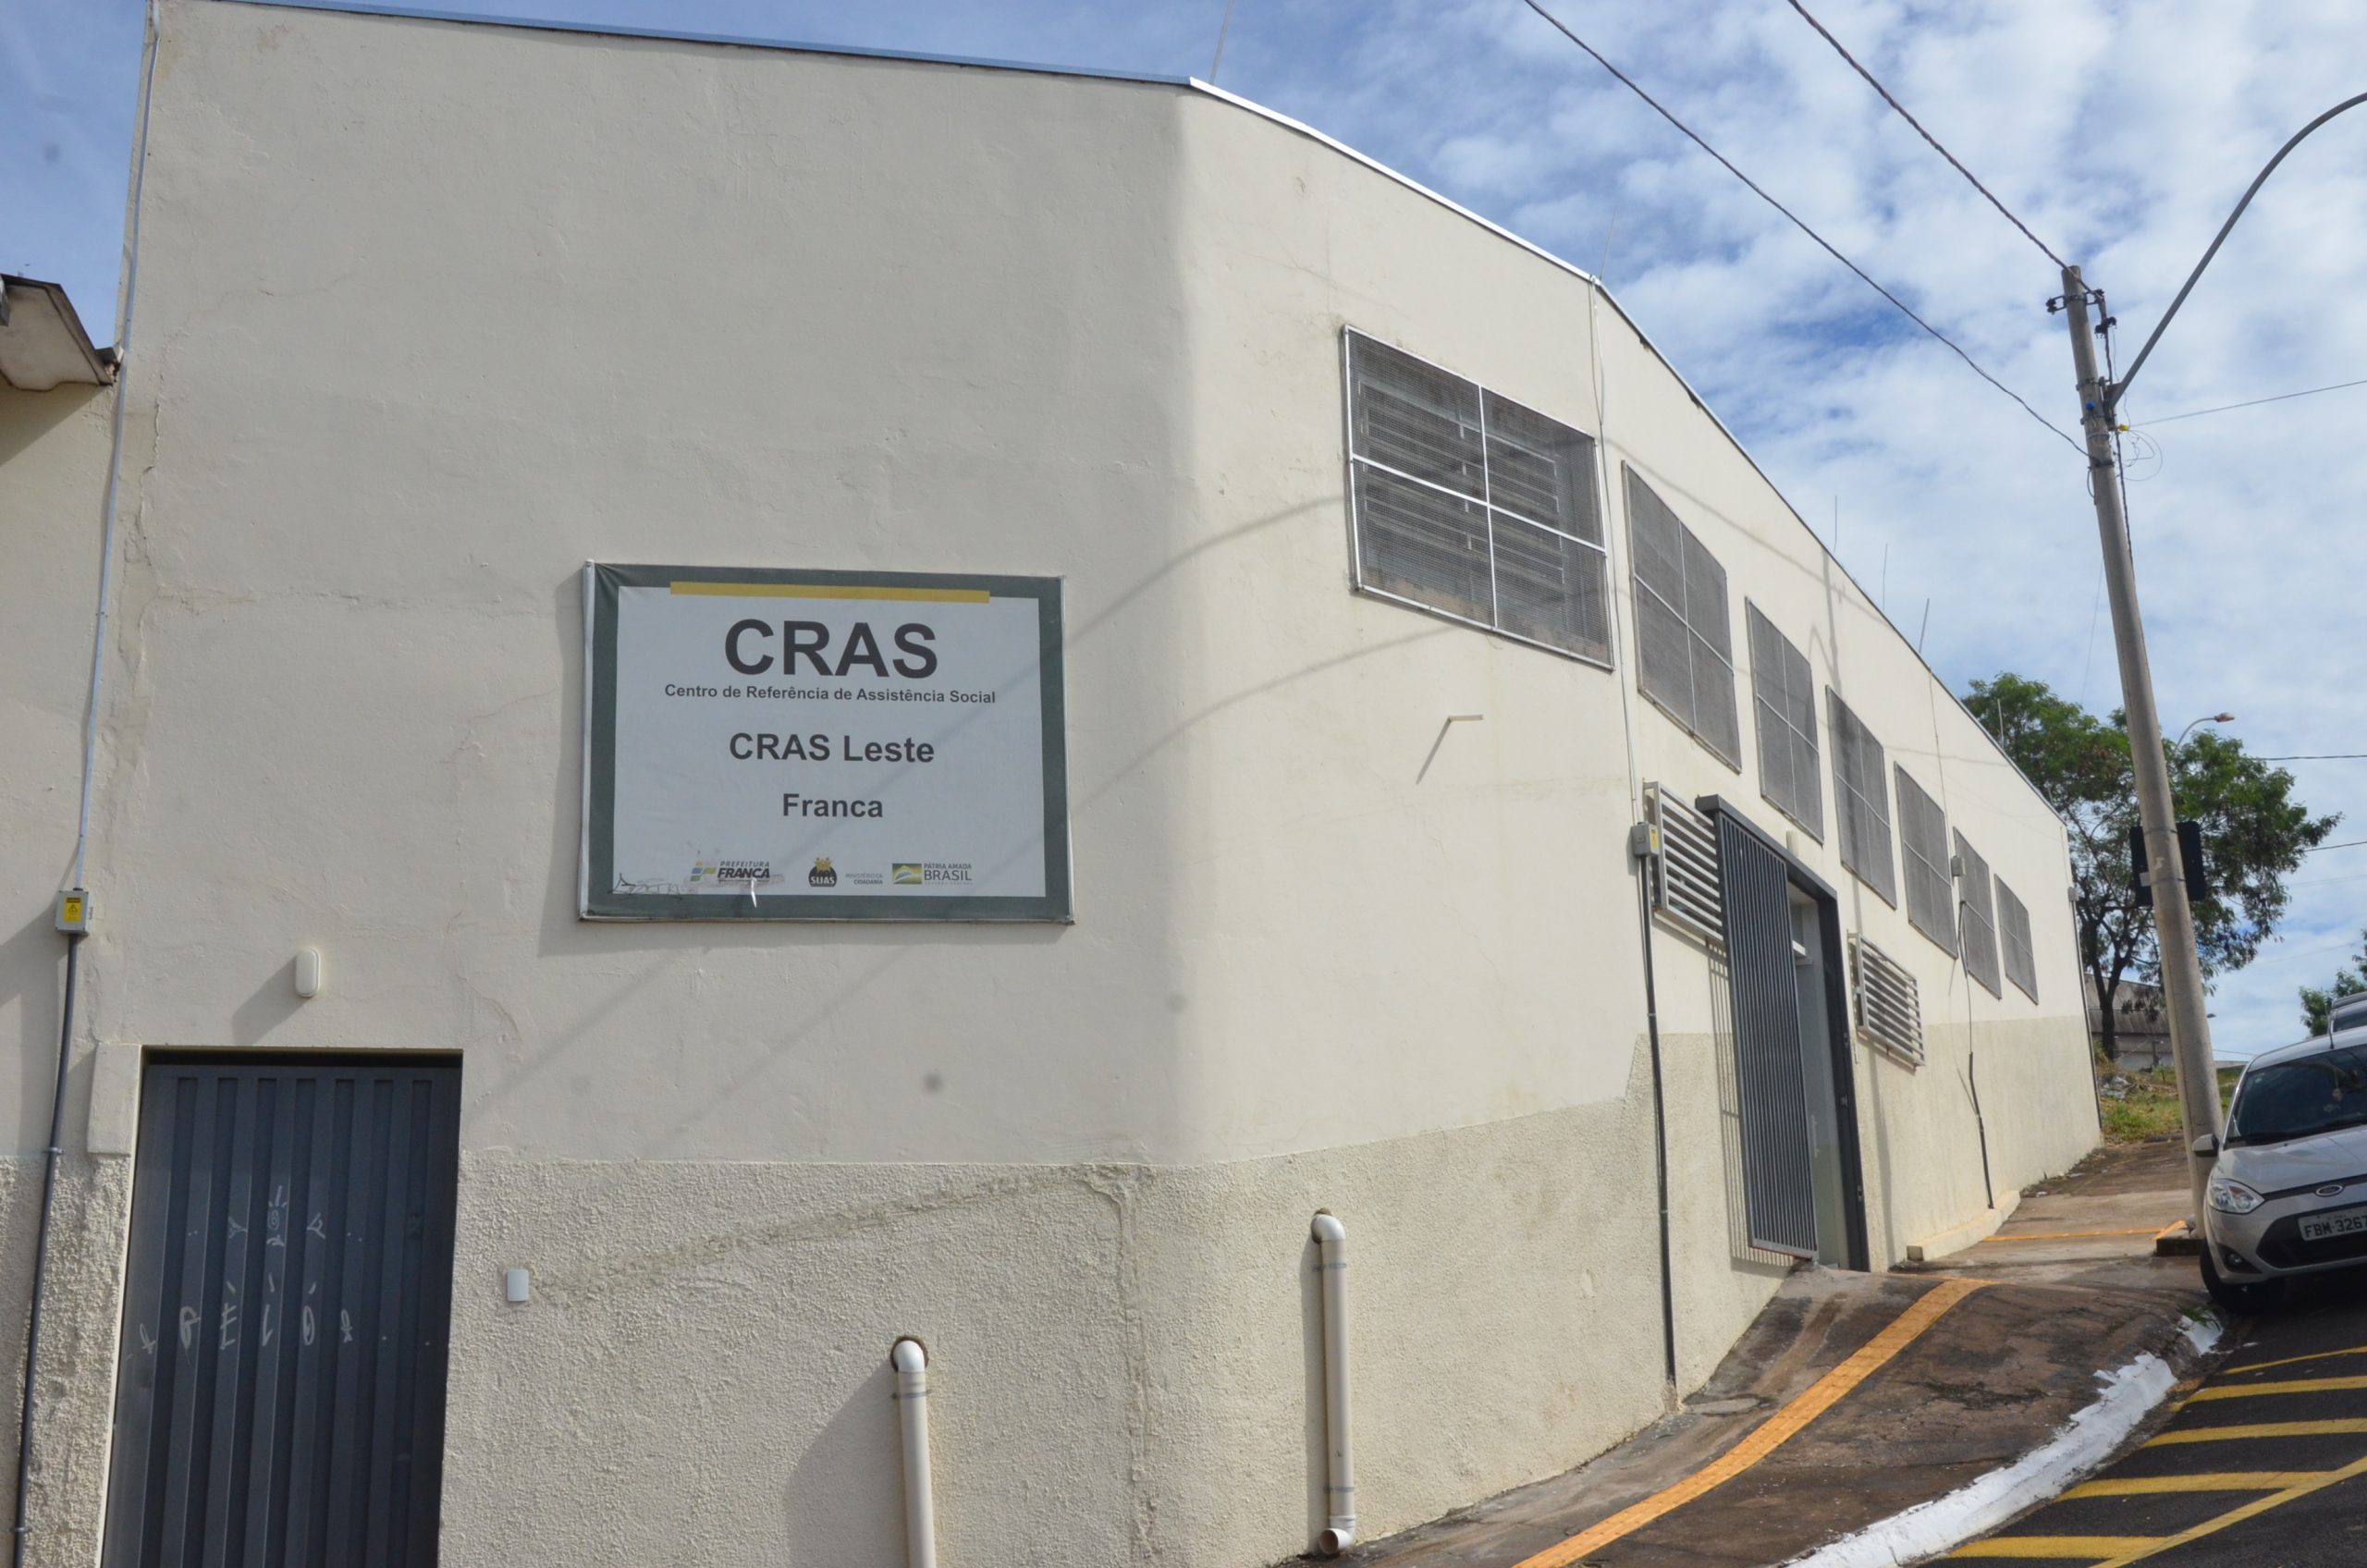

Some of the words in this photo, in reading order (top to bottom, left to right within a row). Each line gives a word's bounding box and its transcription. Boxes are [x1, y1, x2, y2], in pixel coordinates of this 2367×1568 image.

[724, 619, 938, 680] CRAS
[664, 683, 718, 698] Centro
[722, 685, 742, 698] de
[746, 685, 829, 700] Referência
[834, 687, 852, 701] de
[856, 688, 945, 703] Assistência
[950, 690, 996, 704] Social
[730, 732, 831, 762] CRAS
[843, 735, 935, 763] Leste
[783, 793, 884, 818] Franca
[717, 867, 770, 878] FRANCA
[810, 876, 836, 885] SUAS
[924, 869, 974, 881] BRASIL
